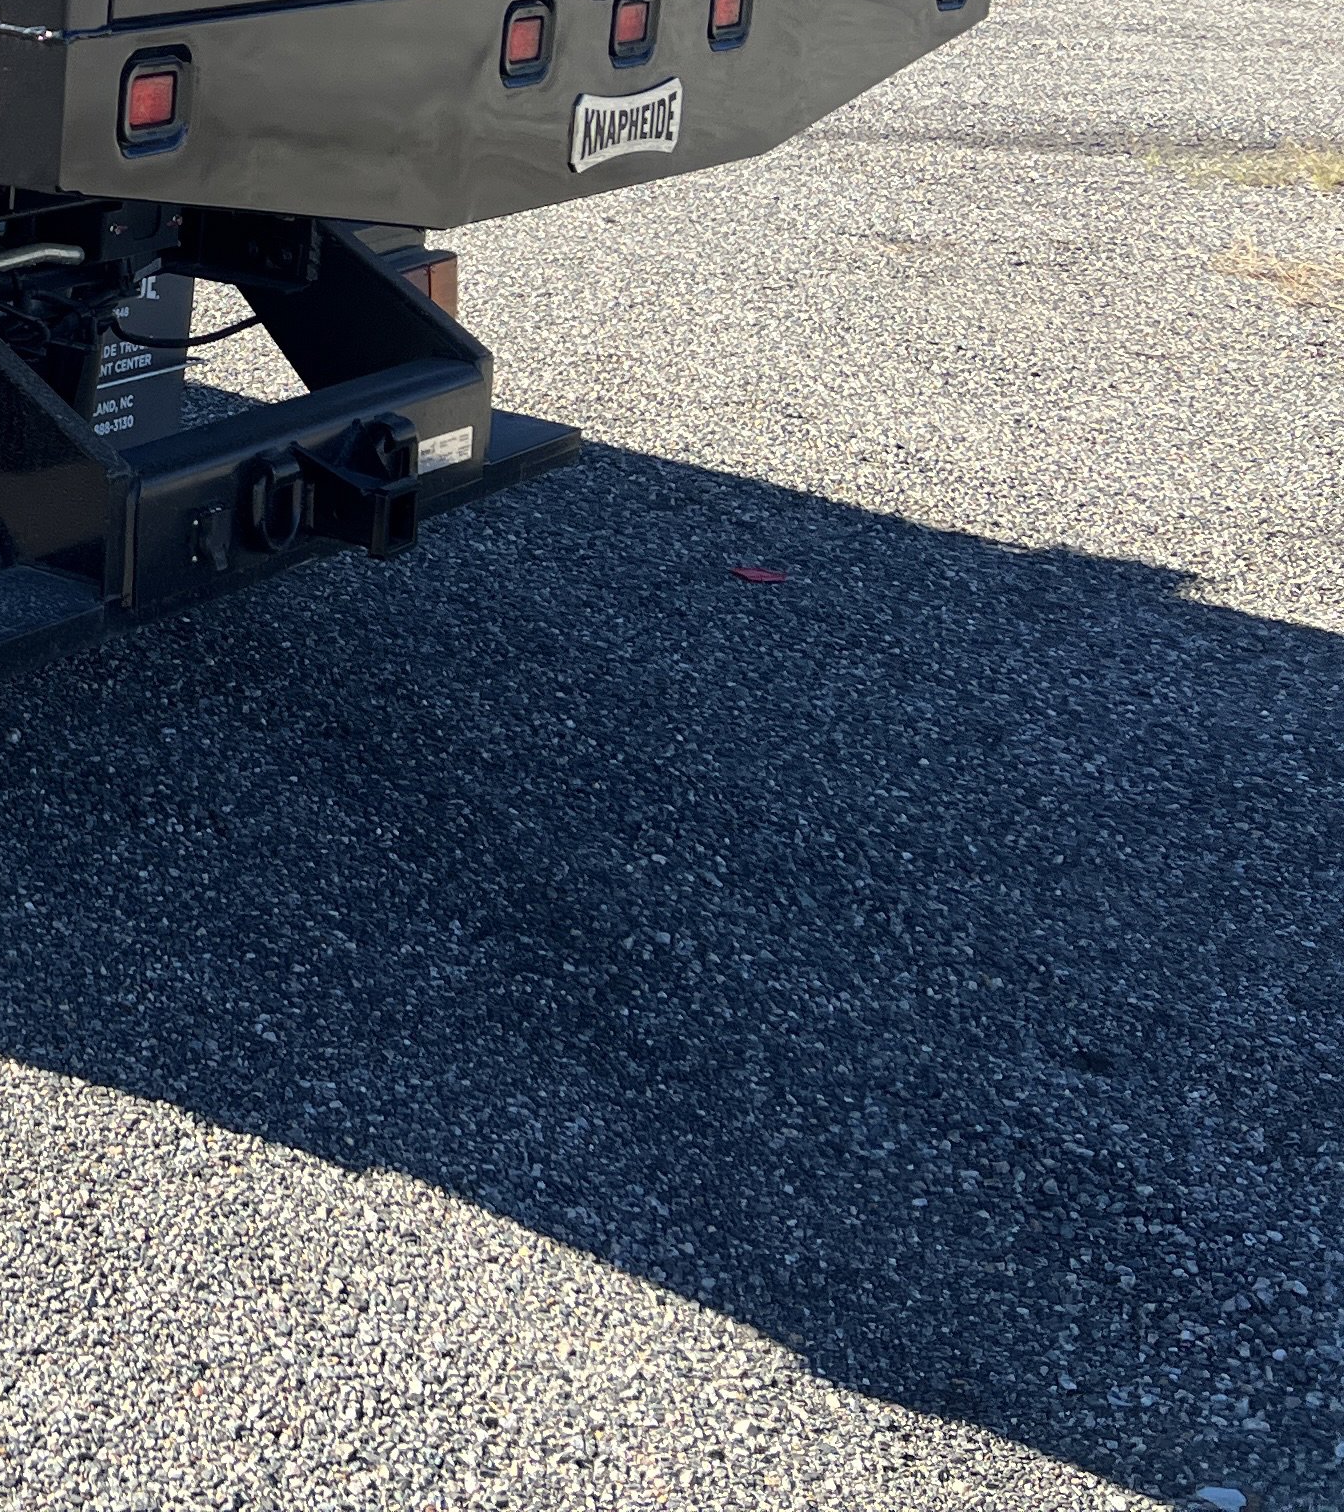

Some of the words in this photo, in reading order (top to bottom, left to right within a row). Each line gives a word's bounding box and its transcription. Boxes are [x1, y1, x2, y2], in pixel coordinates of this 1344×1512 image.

[580, 90, 678, 160] KNAPHEIDE
[115, 353, 152, 374] CENTER
[120, 394, 135, 410] NC
